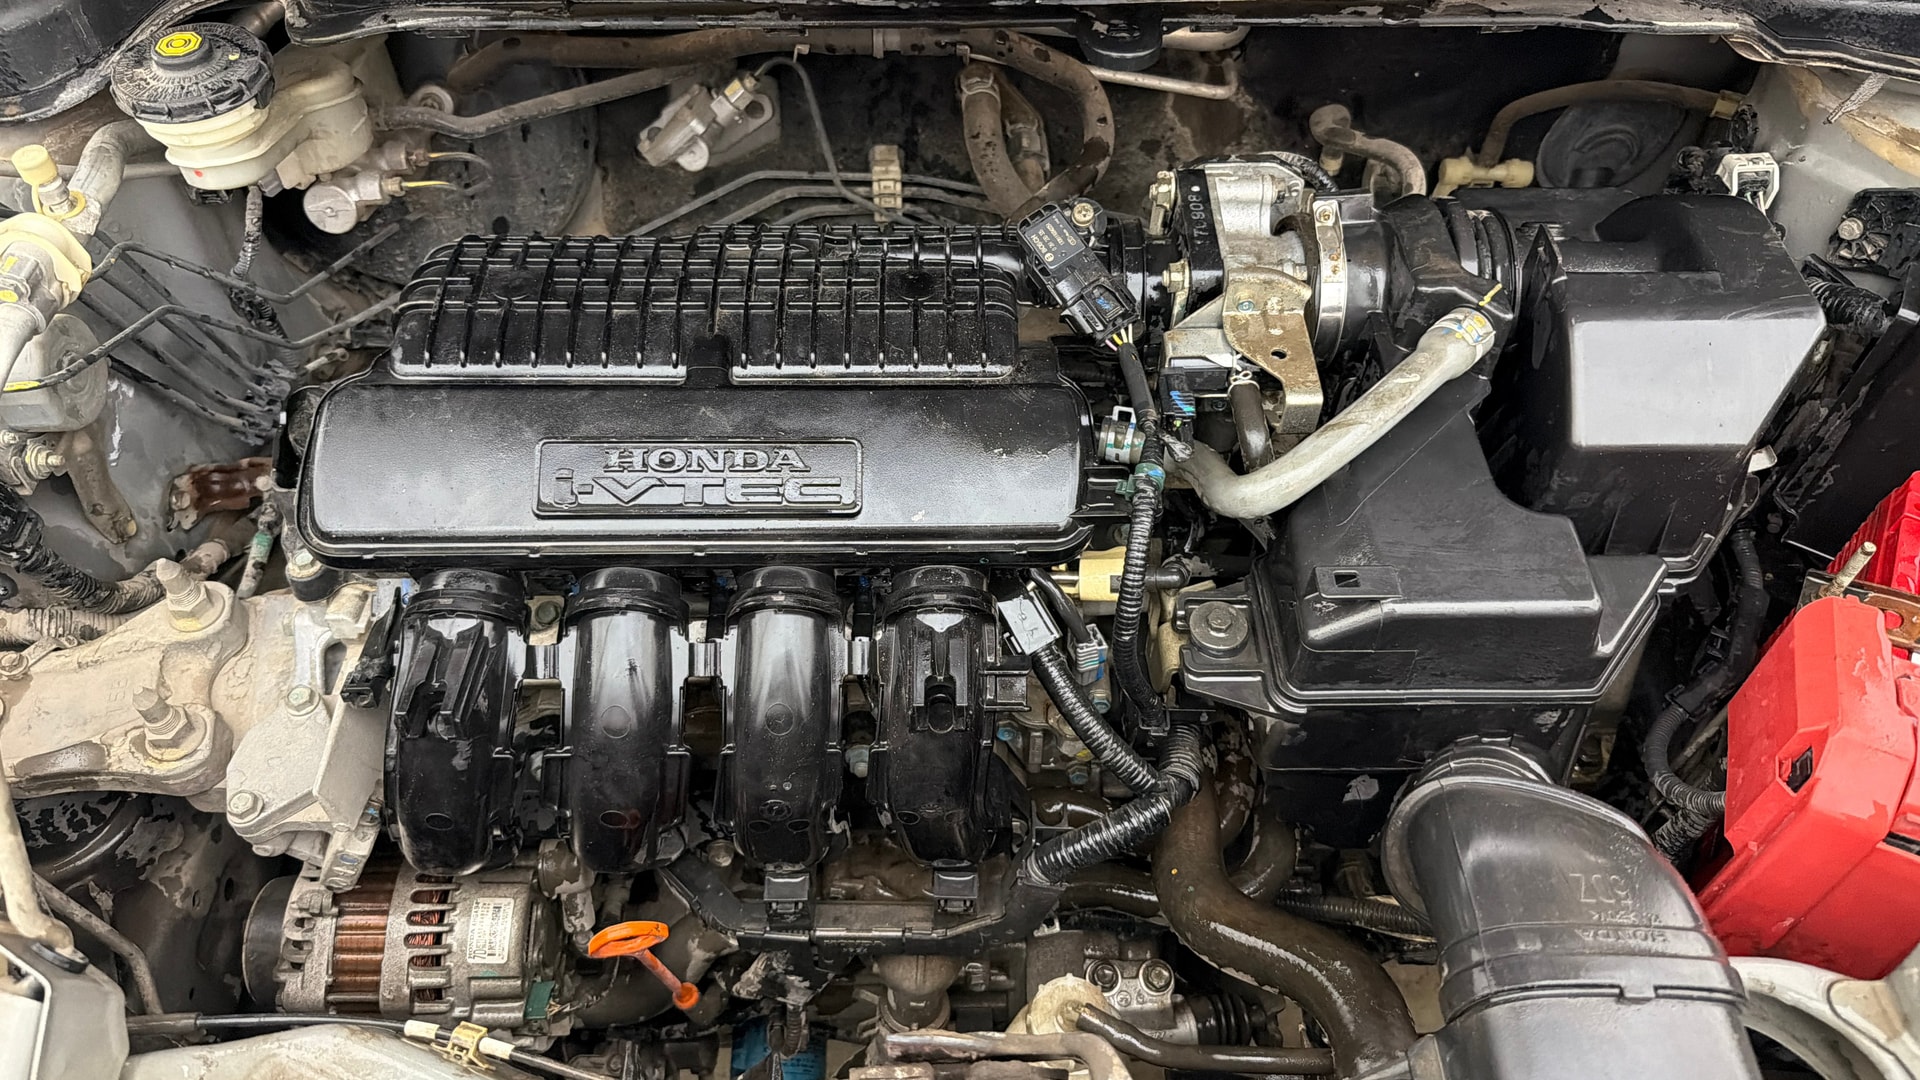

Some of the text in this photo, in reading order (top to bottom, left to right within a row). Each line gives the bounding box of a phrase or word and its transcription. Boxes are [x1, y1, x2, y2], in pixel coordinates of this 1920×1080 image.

[603, 447, 811, 473] HONDA
[553, 467, 857, 507] i-VTEC
[467, 929, 476, 960] HONDA
